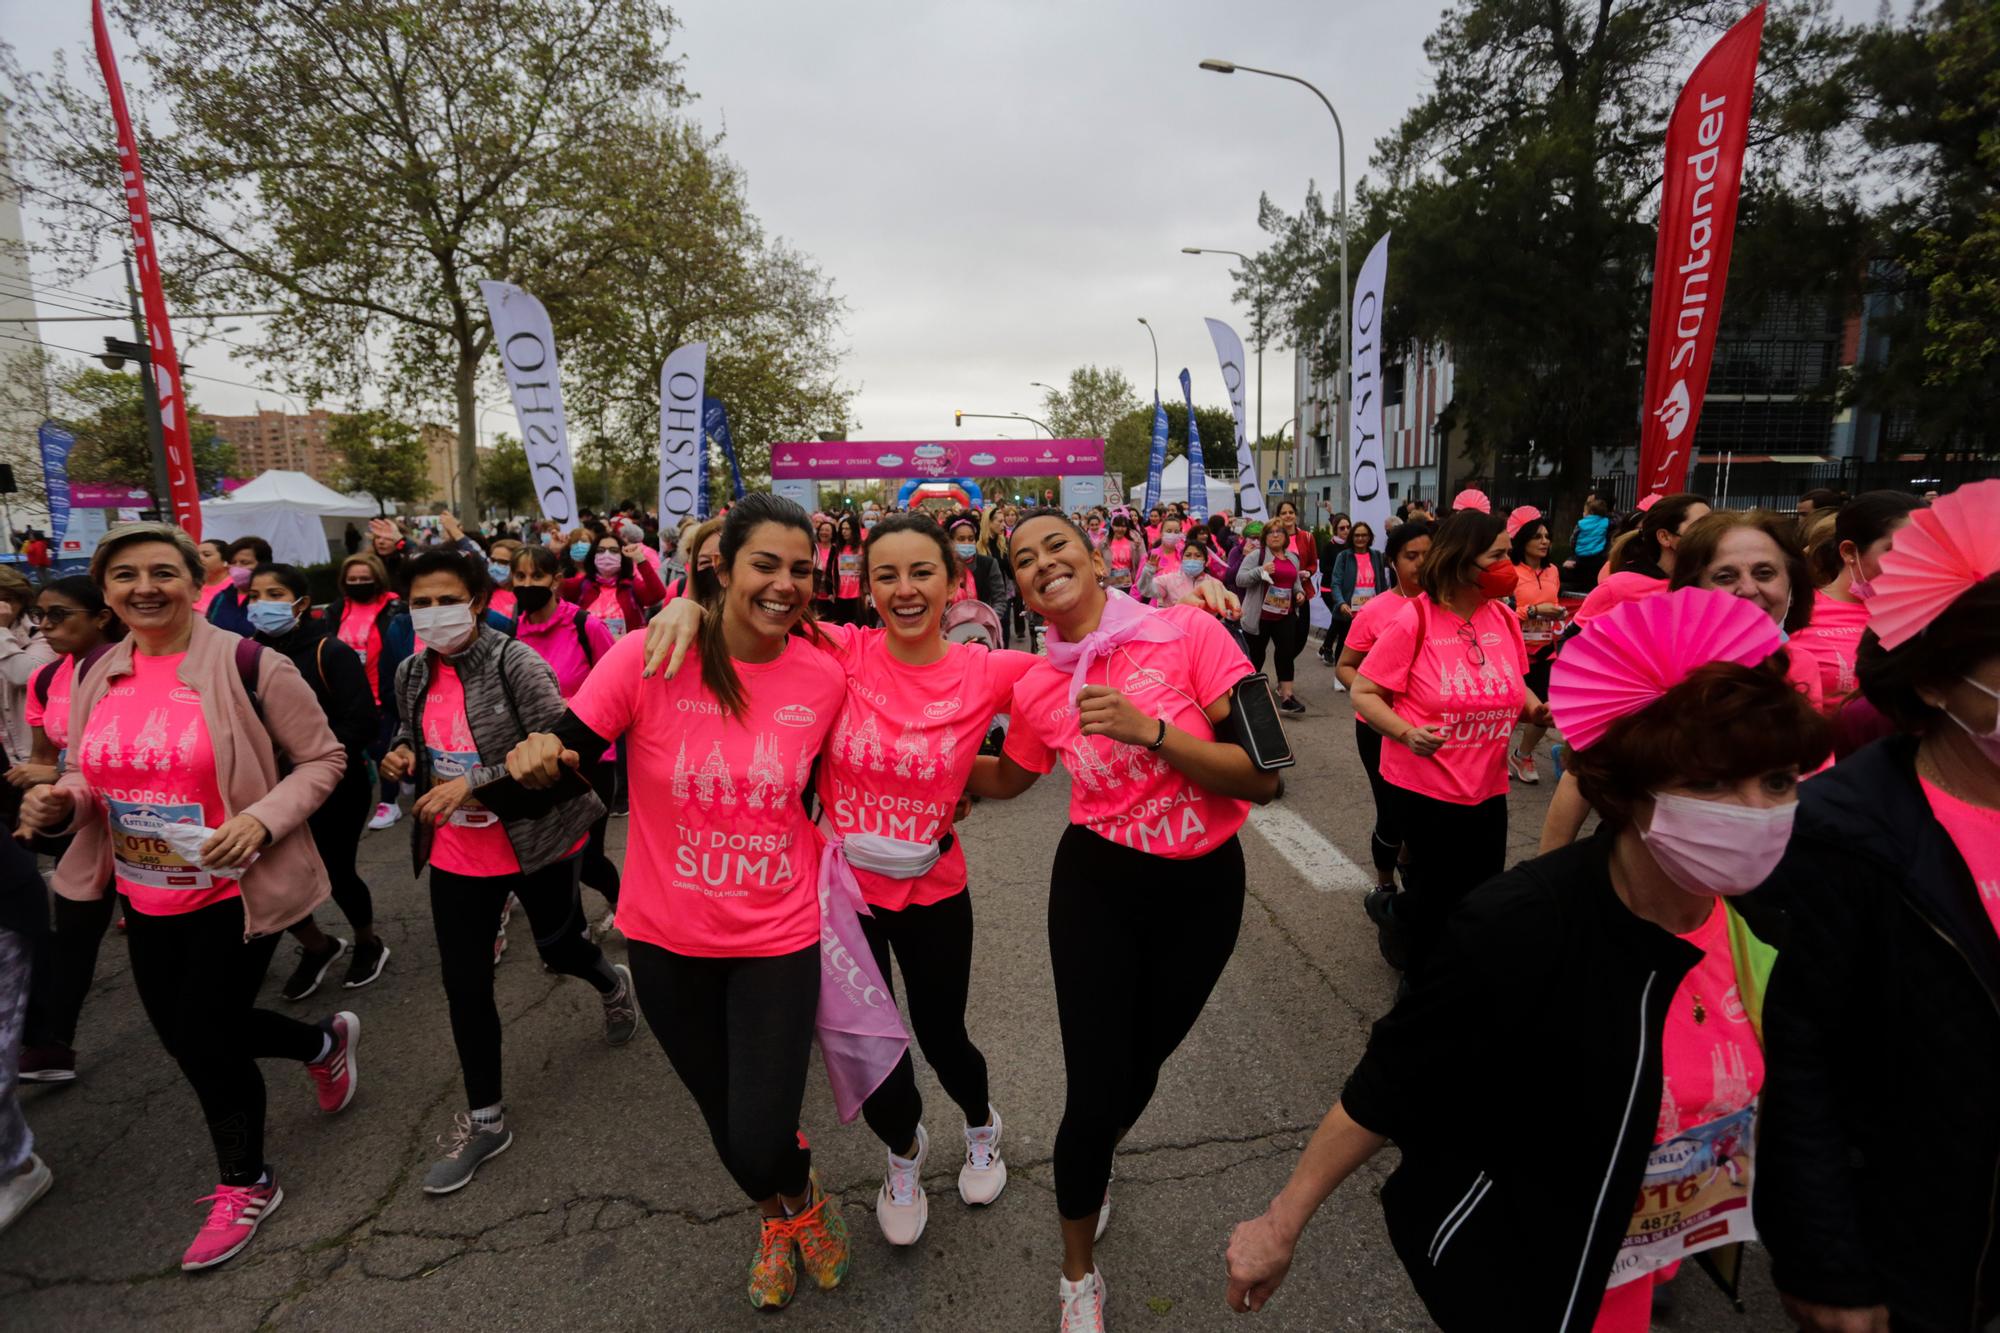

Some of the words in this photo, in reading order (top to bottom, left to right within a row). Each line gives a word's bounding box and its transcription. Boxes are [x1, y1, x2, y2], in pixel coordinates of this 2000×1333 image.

[1669, 92, 1727, 371] Santander
[1353, 290, 1380, 502] OYSHO
[664, 371, 699, 515] OYSHO
[818, 458, 840, 466] ZURICH
[1076, 455, 1098, 463] ZURICH
[676, 699, 732, 717] OYSHO
[1050, 705, 1072, 722] OYS
[1440, 712, 1460, 724] TU
[1465, 707, 1519, 721] DORSAL
[1439, 720, 1513, 742] SUMA
[834, 780, 858, 802] TU
[864, 794, 947, 818] DORSAL
[834, 800, 941, 844] SUMA
[1086, 807, 1206, 852] UMA
[675, 824, 701, 846] TU
[710, 832, 794, 852] DORSAL
[675, 845, 794, 886] SUMA
[1641, 1211, 1682, 1231] 4872
